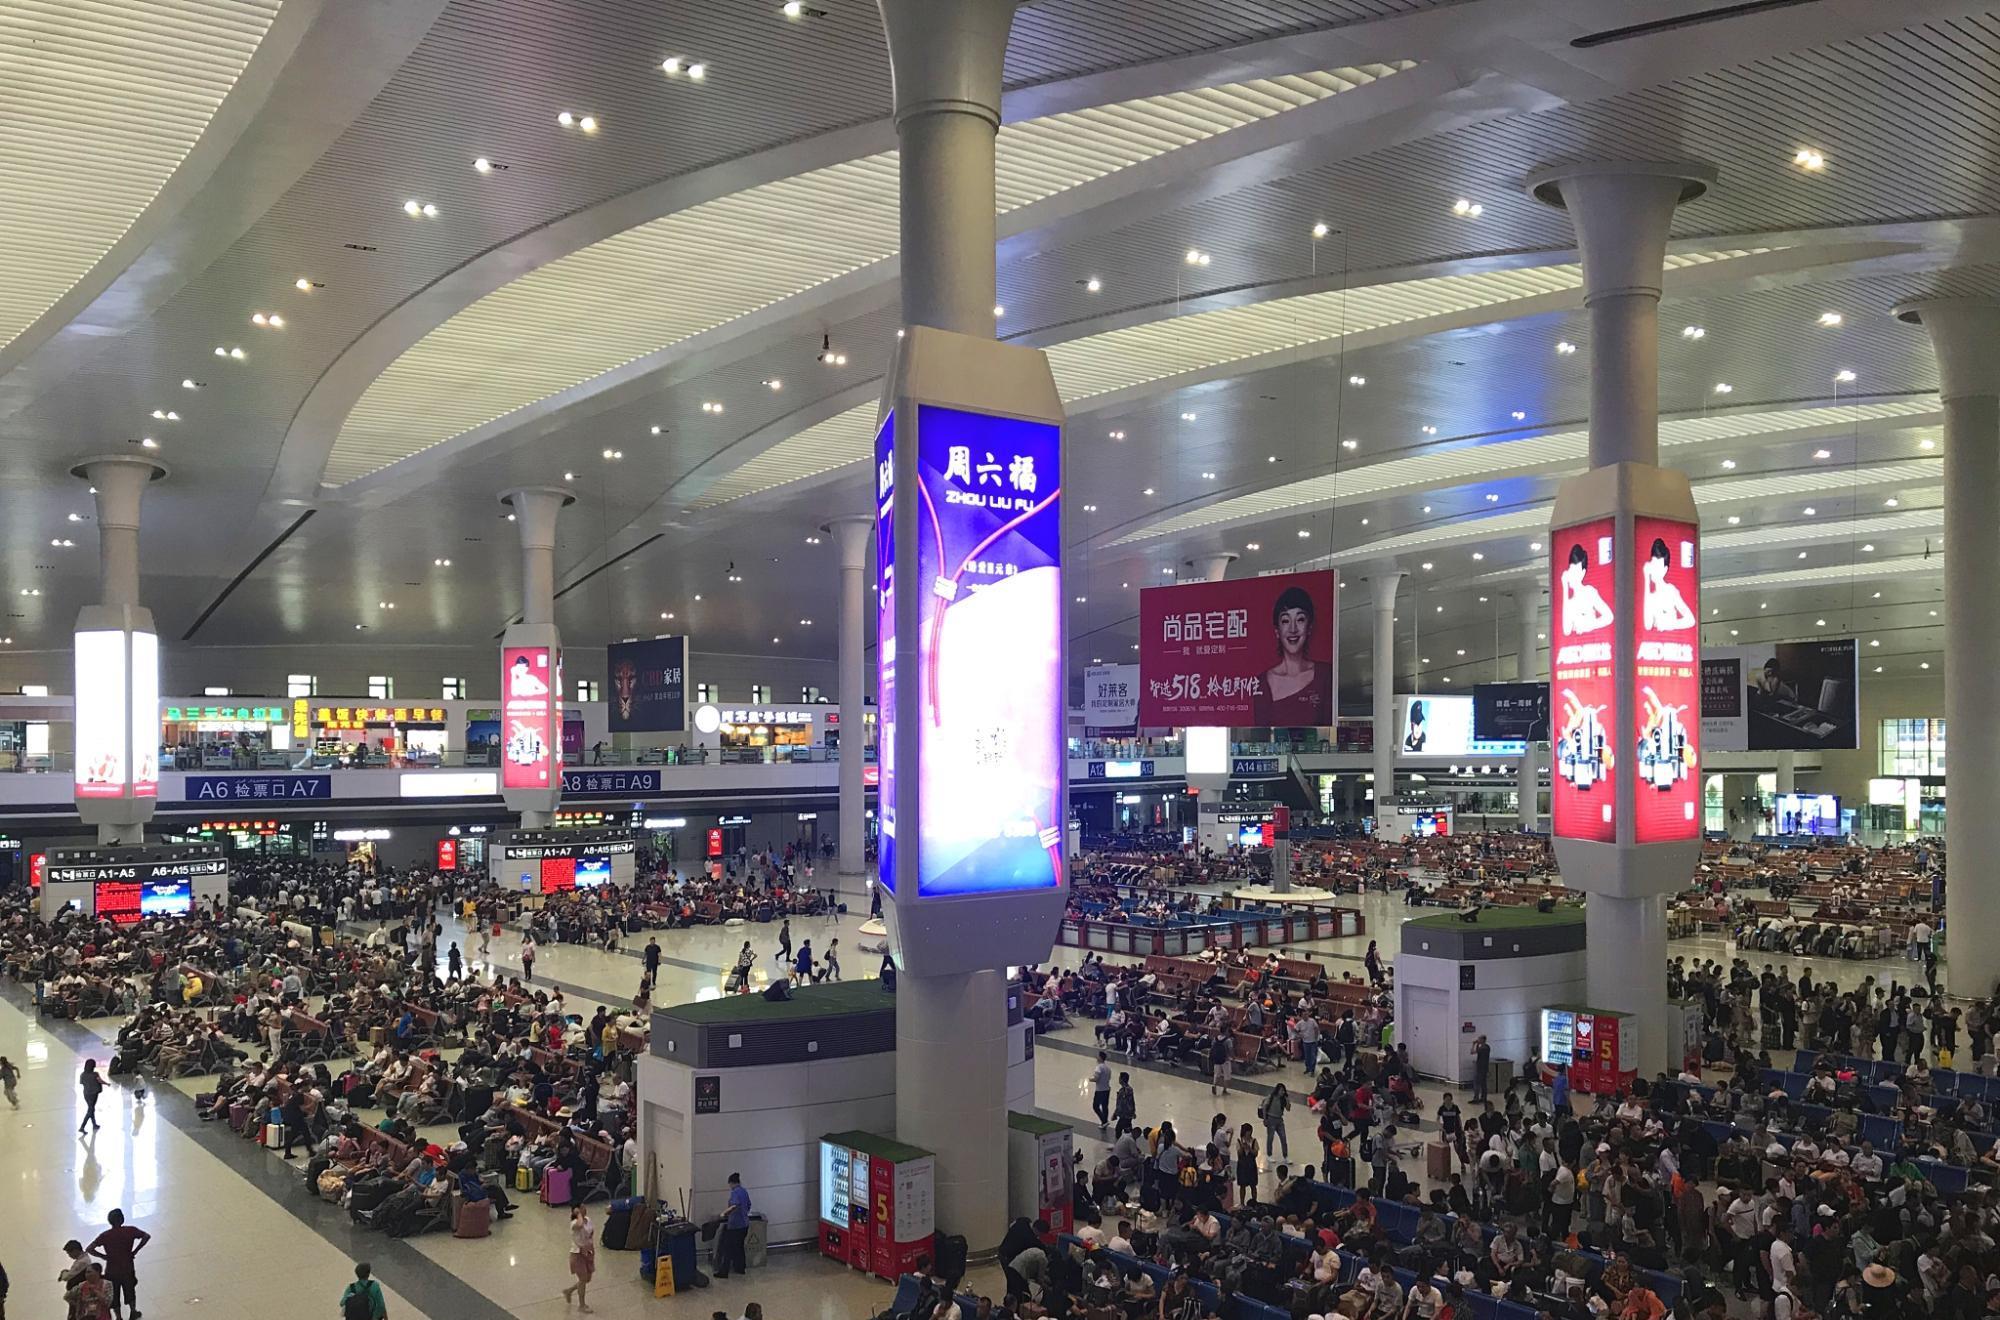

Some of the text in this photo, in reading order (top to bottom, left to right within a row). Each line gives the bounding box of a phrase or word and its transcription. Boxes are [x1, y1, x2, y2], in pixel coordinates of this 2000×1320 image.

[943, 446, 1037, 493] 周六福
[945, 490, 1034, 511] ZHOU LIU FU
[1163, 609, 1247, 642] 尚品宅配
[663, 667, 682, 685] 家居
[1098, 682, 1128, 698] 好莱客
[1236, 761, 1255, 773] A14
[199, 779, 319, 798] A6 检票口 A7
[586, 777, 626, 790] 检票口
[630, 774, 652, 789] A9
[544, 847, 572, 857] A1-A7
[98, 869, 136, 879] A1-A5
[152, 865, 189, 877] A6-A15
[1600, 1040, 1613, 1060] 5
[876, 1193, 888, 1222] 5
